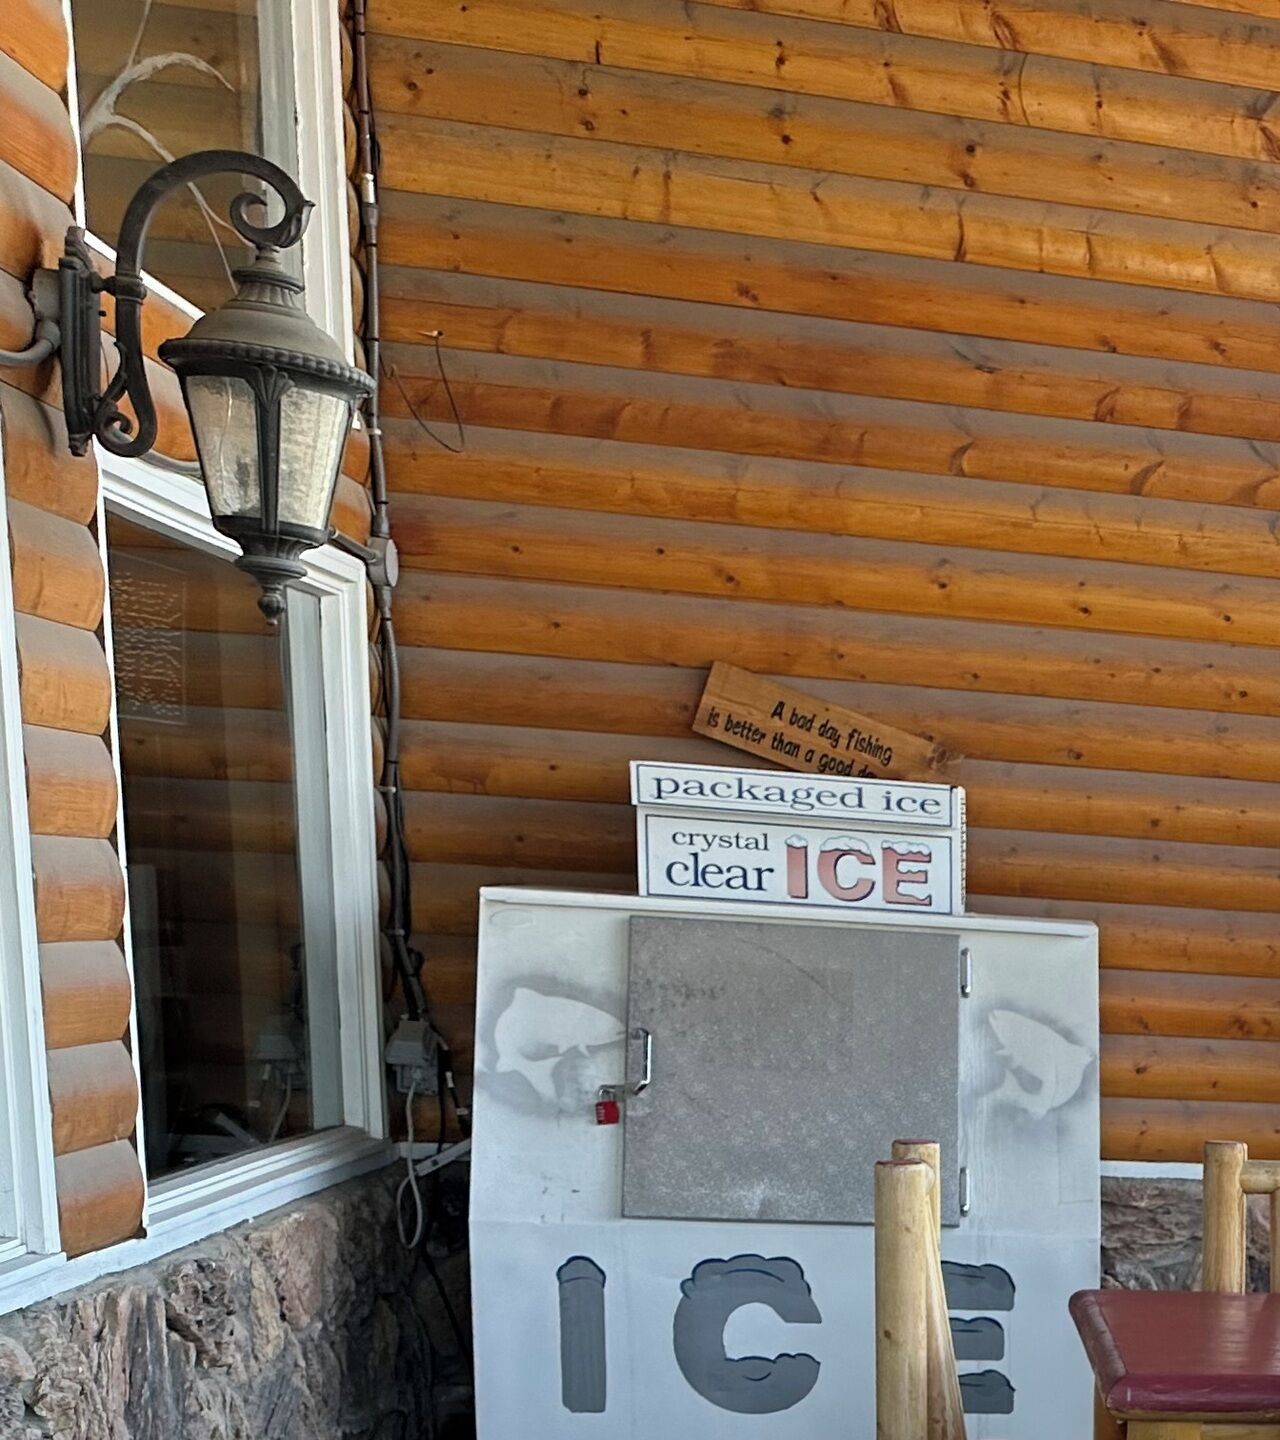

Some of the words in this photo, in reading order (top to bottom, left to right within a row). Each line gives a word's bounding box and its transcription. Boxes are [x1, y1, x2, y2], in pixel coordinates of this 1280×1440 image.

[707, 707, 719, 728] is
[724, 714, 766, 744] better
[771, 732, 801, 757] than
[804, 748, 814, 763] a
[819, 753, 855, 777] good
[771, 700, 783, 720] A
[789, 707, 816, 732] bad
[818, 719, 841, 749] day
[847, 728, 893, 767] fishing
[653, 776, 864, 812] packaged
[881, 790, 942, 816] ice
[665, 852, 775, 892] clear
[784, 833, 933, 906] ICE
[671, 830, 770, 851] crystal
